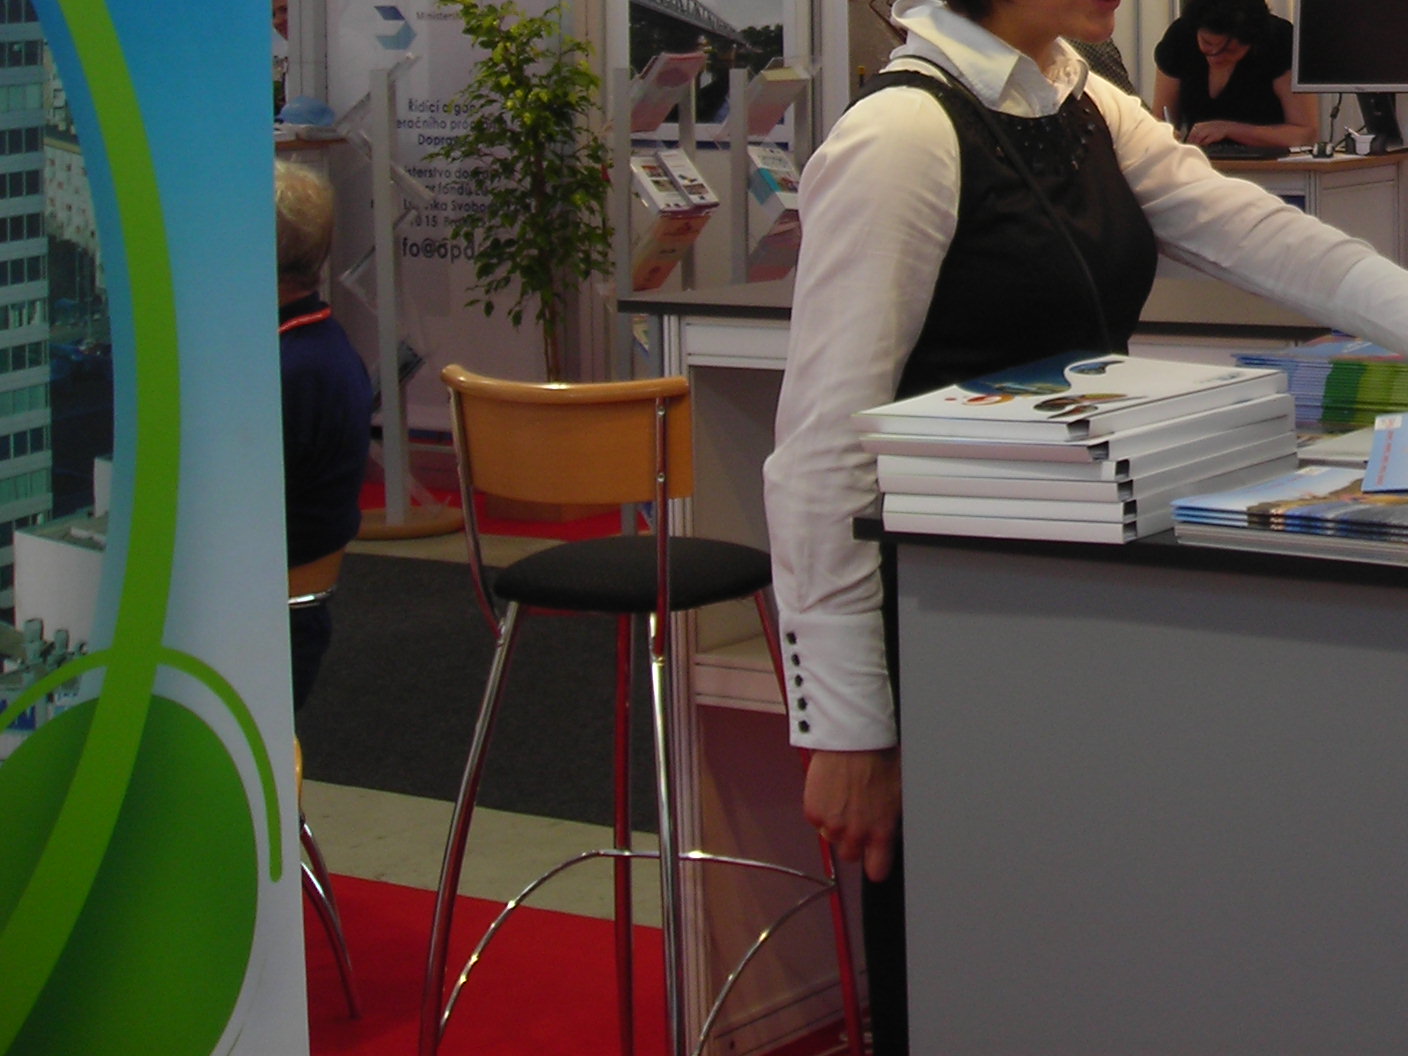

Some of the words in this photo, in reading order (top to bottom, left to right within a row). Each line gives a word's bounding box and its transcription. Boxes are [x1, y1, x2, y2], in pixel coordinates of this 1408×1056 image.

[443, 100, 477, 116] ogán
[396, 117, 447, 130] eračního
[418, 133, 455, 147] Dopra
[451, 199, 487, 212] Svobo
[402, 236, 476, 263] fo@opd
